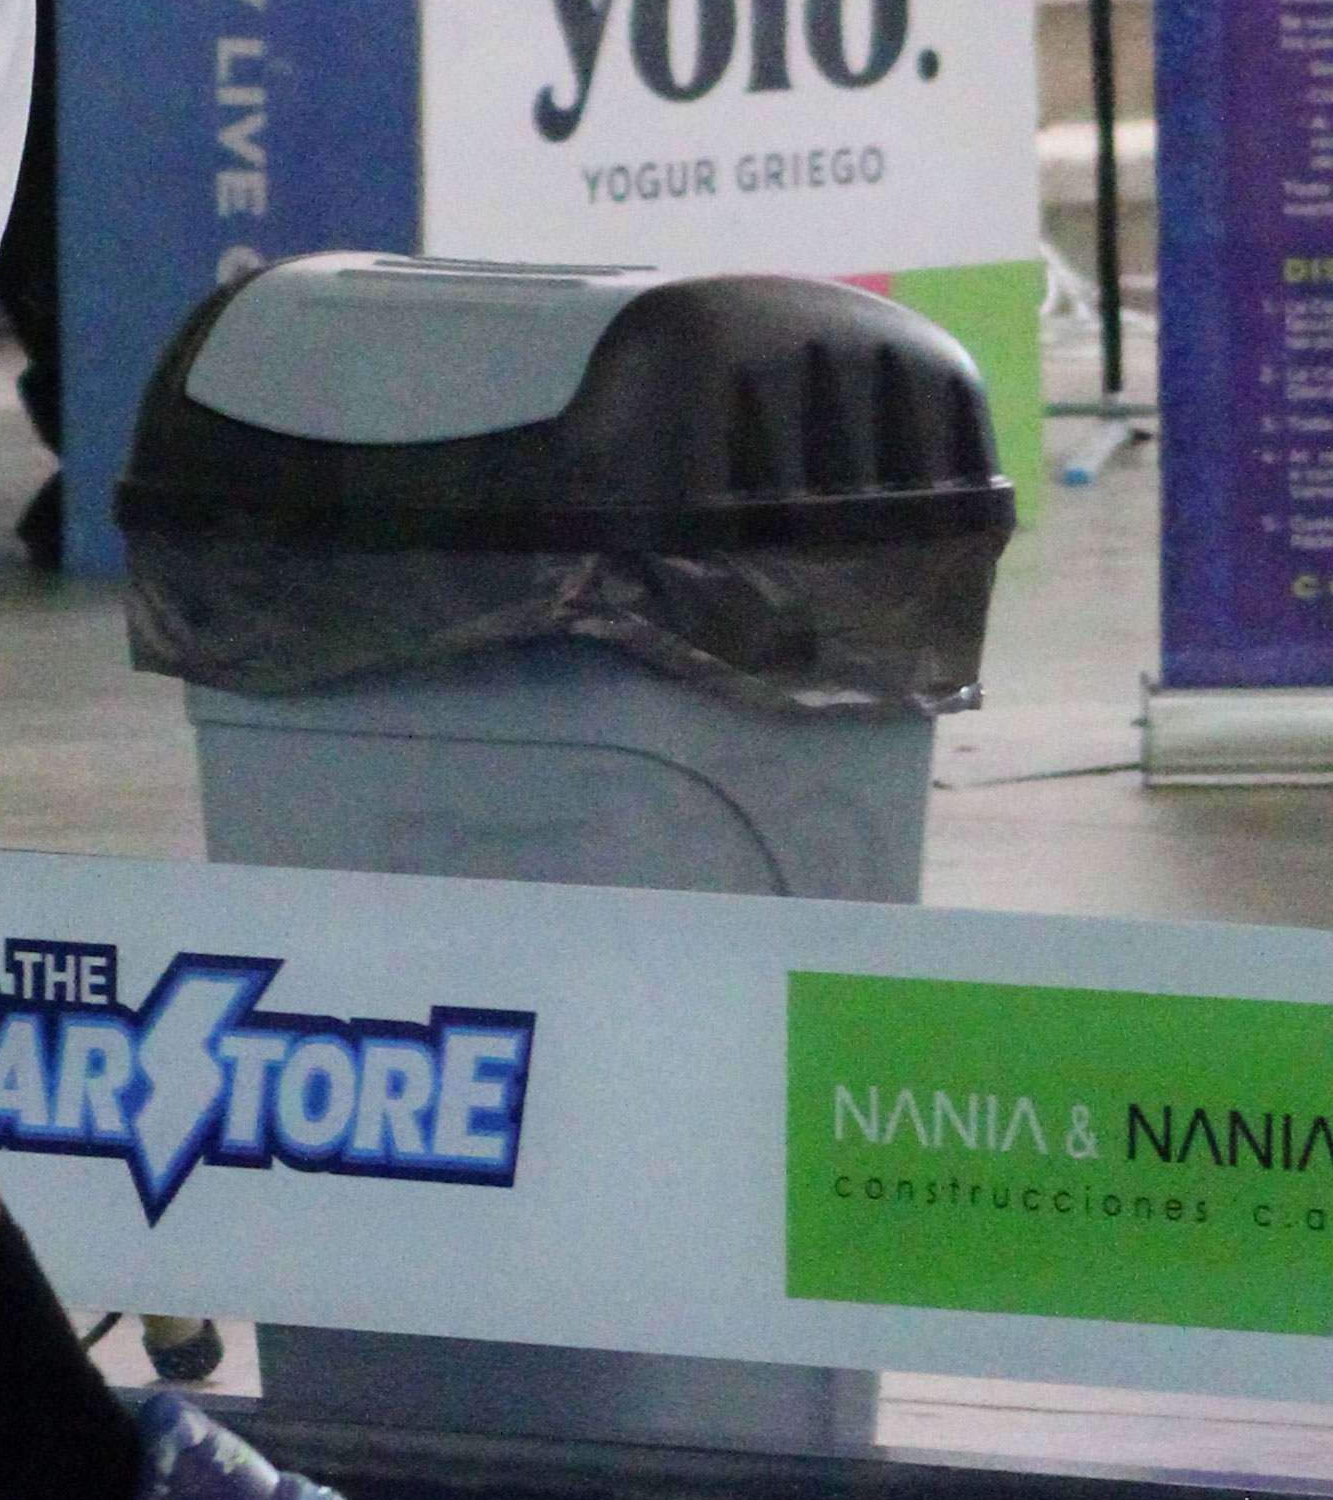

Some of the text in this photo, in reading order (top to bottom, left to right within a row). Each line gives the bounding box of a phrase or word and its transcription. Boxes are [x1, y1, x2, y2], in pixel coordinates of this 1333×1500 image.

[216, 36, 269, 217] LIVE
[581, 146, 885, 204] YOGUR GRIEGO
[13, 950, 108, 1004] THE
[834, 1085, 1333, 1171] NANIA & NANIA
[834, 1173, 1209, 1224] construcciones
